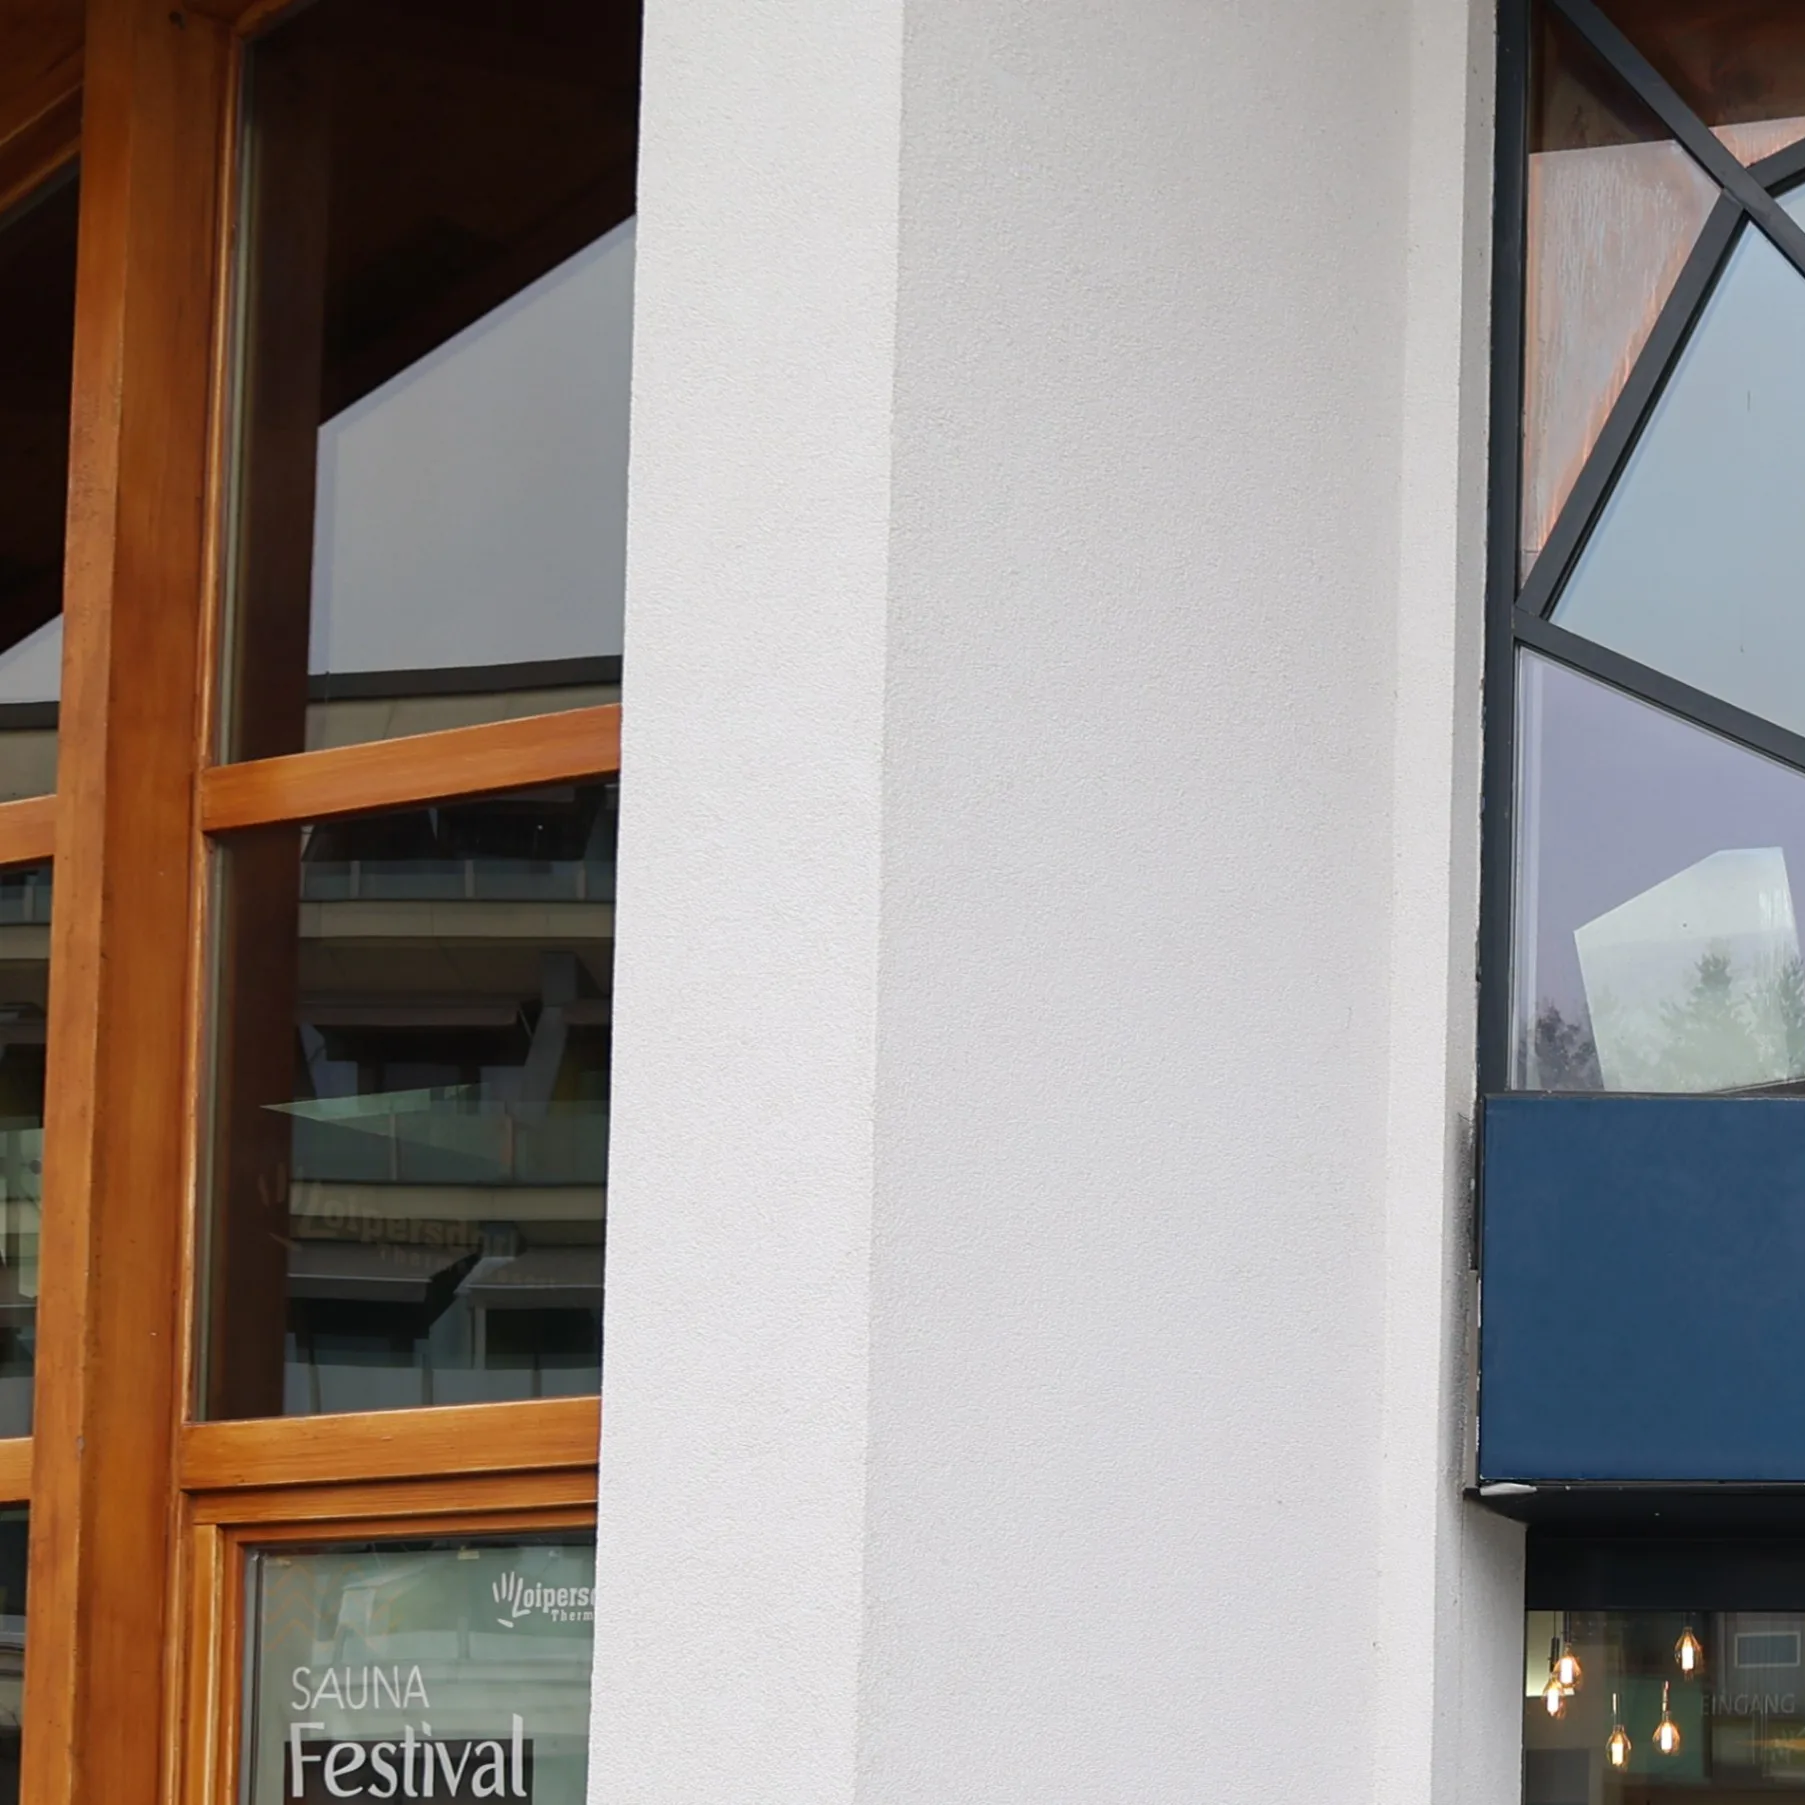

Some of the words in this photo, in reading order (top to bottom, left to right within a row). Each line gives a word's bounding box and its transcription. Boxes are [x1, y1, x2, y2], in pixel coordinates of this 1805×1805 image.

[291, 1665, 431, 1711] SAUNA
[1700, 1692, 1796, 1717] EINGANG
[290, 1713, 528, 1798] Festival
